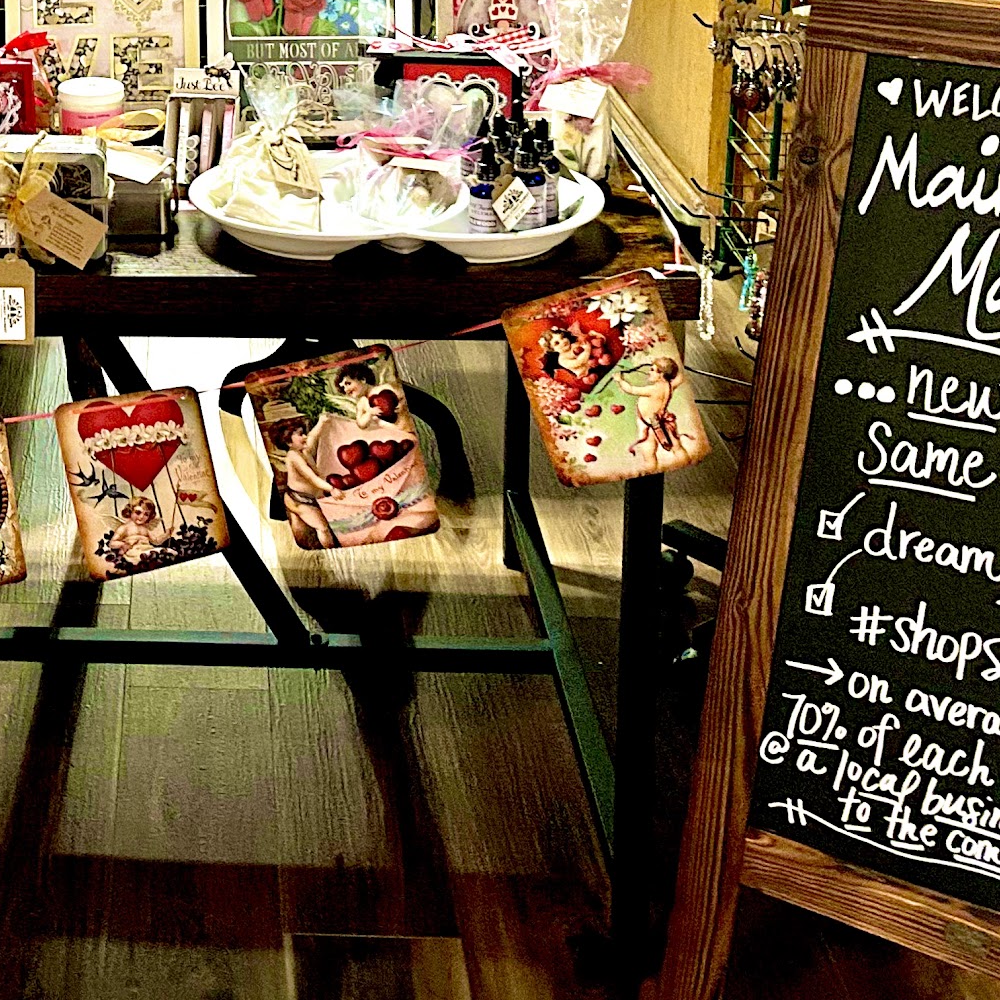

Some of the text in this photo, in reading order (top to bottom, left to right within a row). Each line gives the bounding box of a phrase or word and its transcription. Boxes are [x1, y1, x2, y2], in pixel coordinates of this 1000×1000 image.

[246, 42, 275, 59] BUT
[279, 42, 317, 59] MOST
[320, 41, 340, 58] OF
[175, 77, 200, 90] Just
[858, 132, 1000, 217] Mai
[857, 421, 997, 488] Same
[848, 671, 893, 703] on
[782, 692, 995, 786] 70% of each
[797, 749, 827, 774] a
[832, 749, 921, 805] local
[838, 786, 872, 822] to
[883, 804, 938, 848] the
